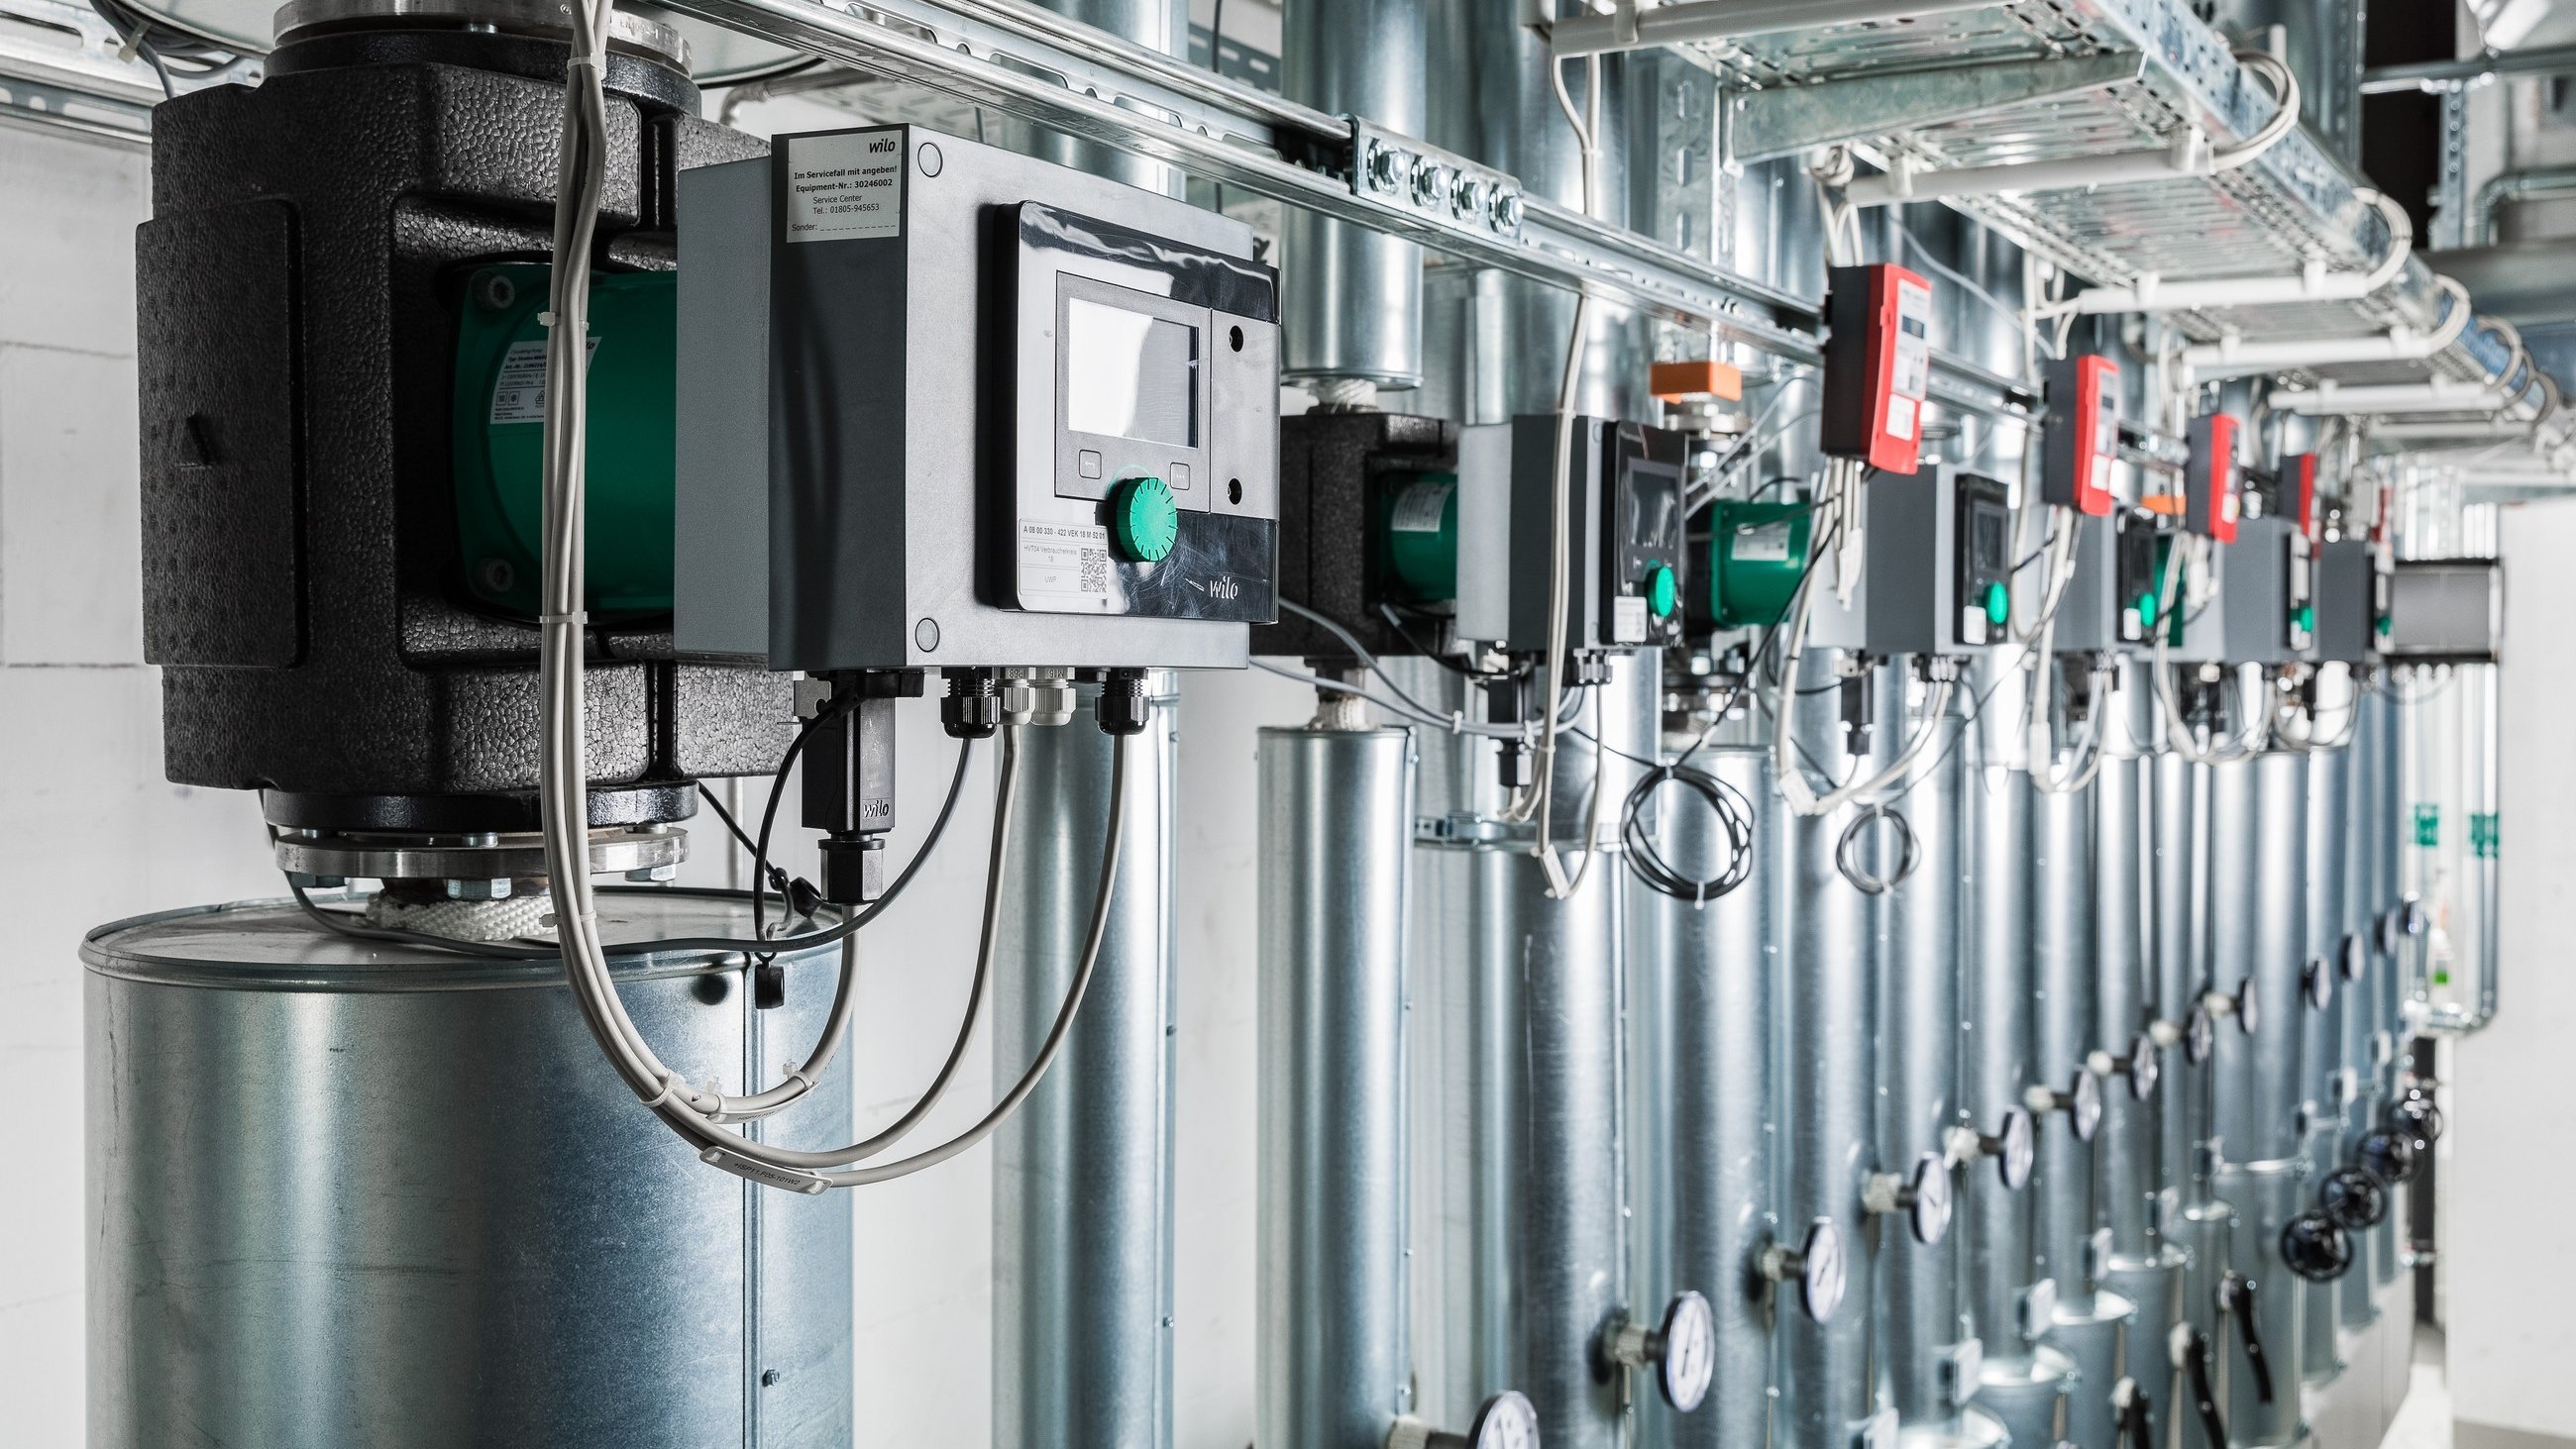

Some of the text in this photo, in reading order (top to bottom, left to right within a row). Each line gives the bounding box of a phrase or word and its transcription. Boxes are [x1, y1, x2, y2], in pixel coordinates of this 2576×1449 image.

[869, 139, 896, 153] wilo
[806, 169, 845, 178] Servicefall
[862, 165, 898, 175] angeben!
[796, 178, 893, 193] Equipment-Nr.: 30246002
[813, 203, 880, 215] Tel.: 01805-945653
[1044, 527, 1053, 536] 330
[1057, 528, 1066, 537] 422
[1067, 529, 1079, 538] VEK
[1210, 575, 1238, 599] wilo
[864, 799, 890, 817] wilo
